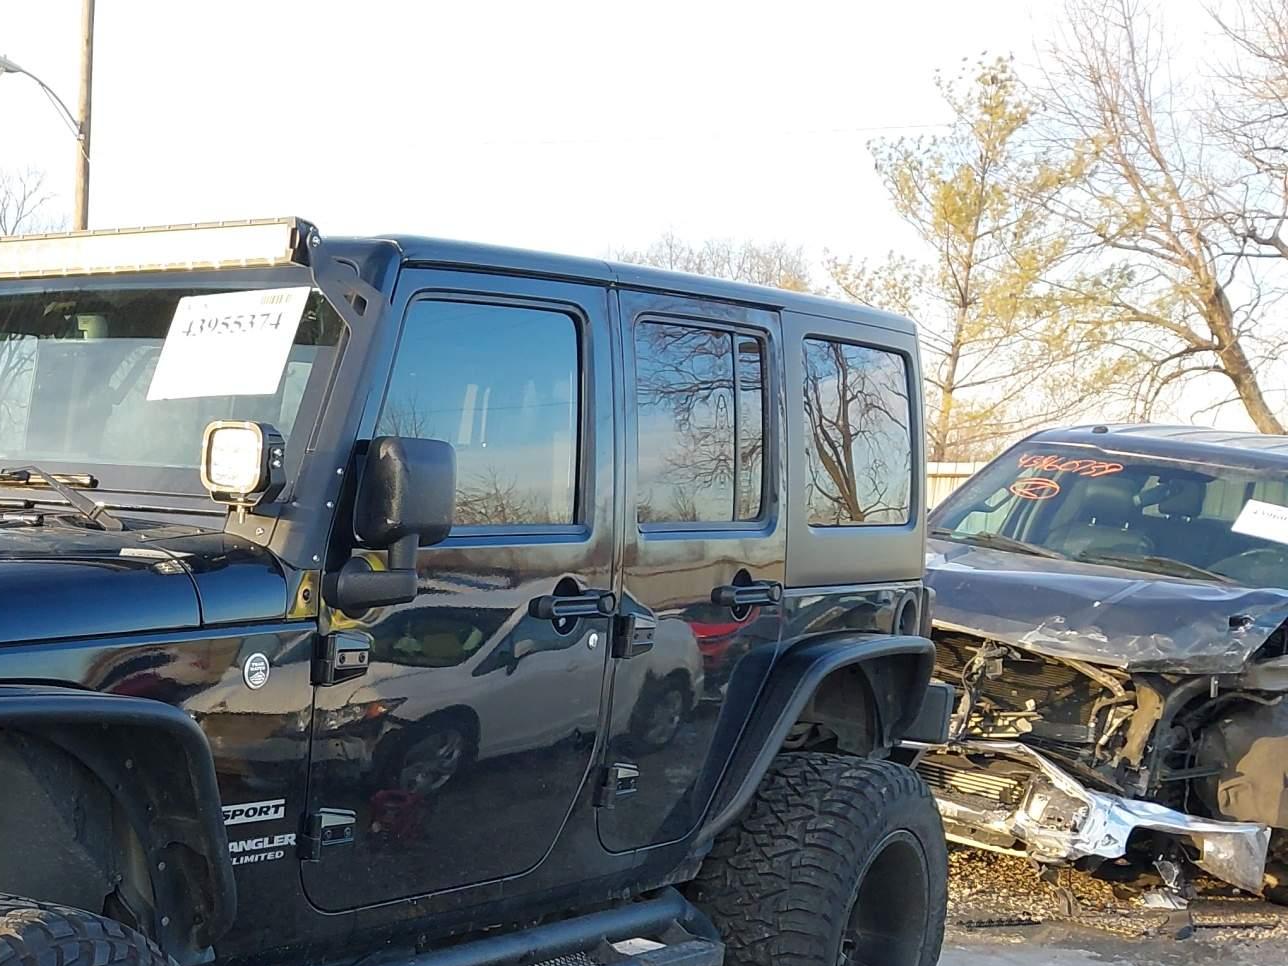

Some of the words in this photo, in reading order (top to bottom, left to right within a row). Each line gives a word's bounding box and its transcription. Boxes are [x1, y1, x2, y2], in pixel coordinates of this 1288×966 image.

[181, 312, 283, 337] 43955374
[222, 804, 282, 821] SPORT
[228, 833, 297, 853] ANGLER
[231, 850, 284, 866] LIMITED
